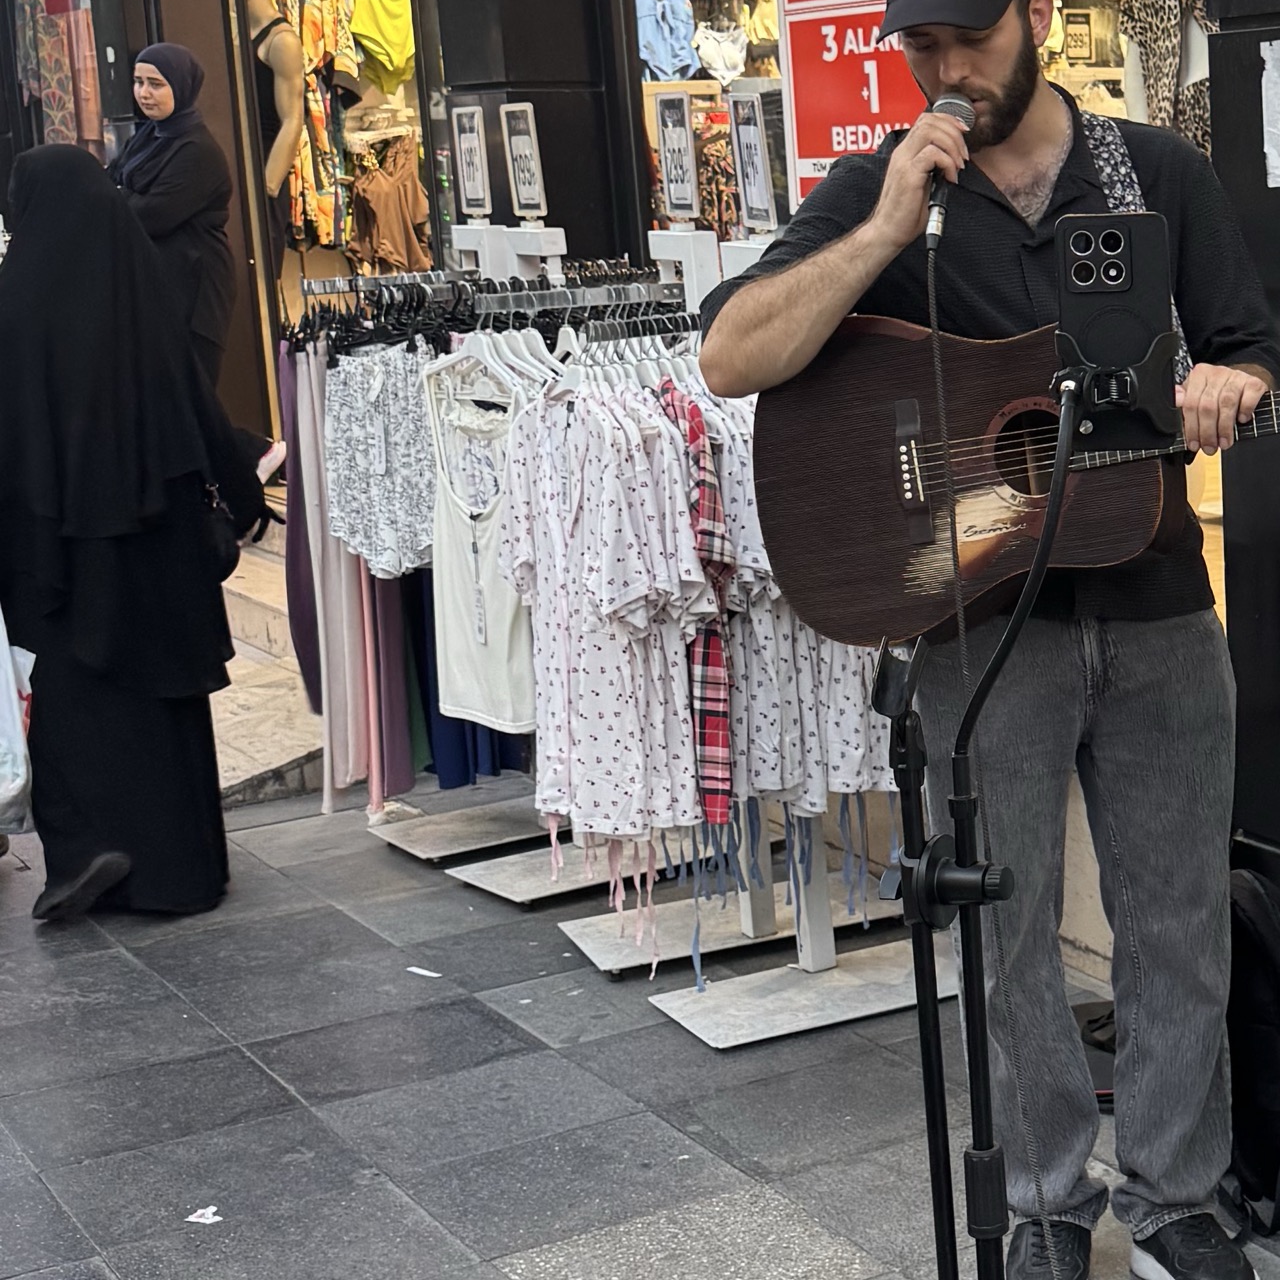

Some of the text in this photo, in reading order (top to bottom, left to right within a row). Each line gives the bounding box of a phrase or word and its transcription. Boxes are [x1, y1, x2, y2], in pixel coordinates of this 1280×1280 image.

[820, 24, 904, 62] 3 ALAN
[811, 160, 828, 173] TÜM
